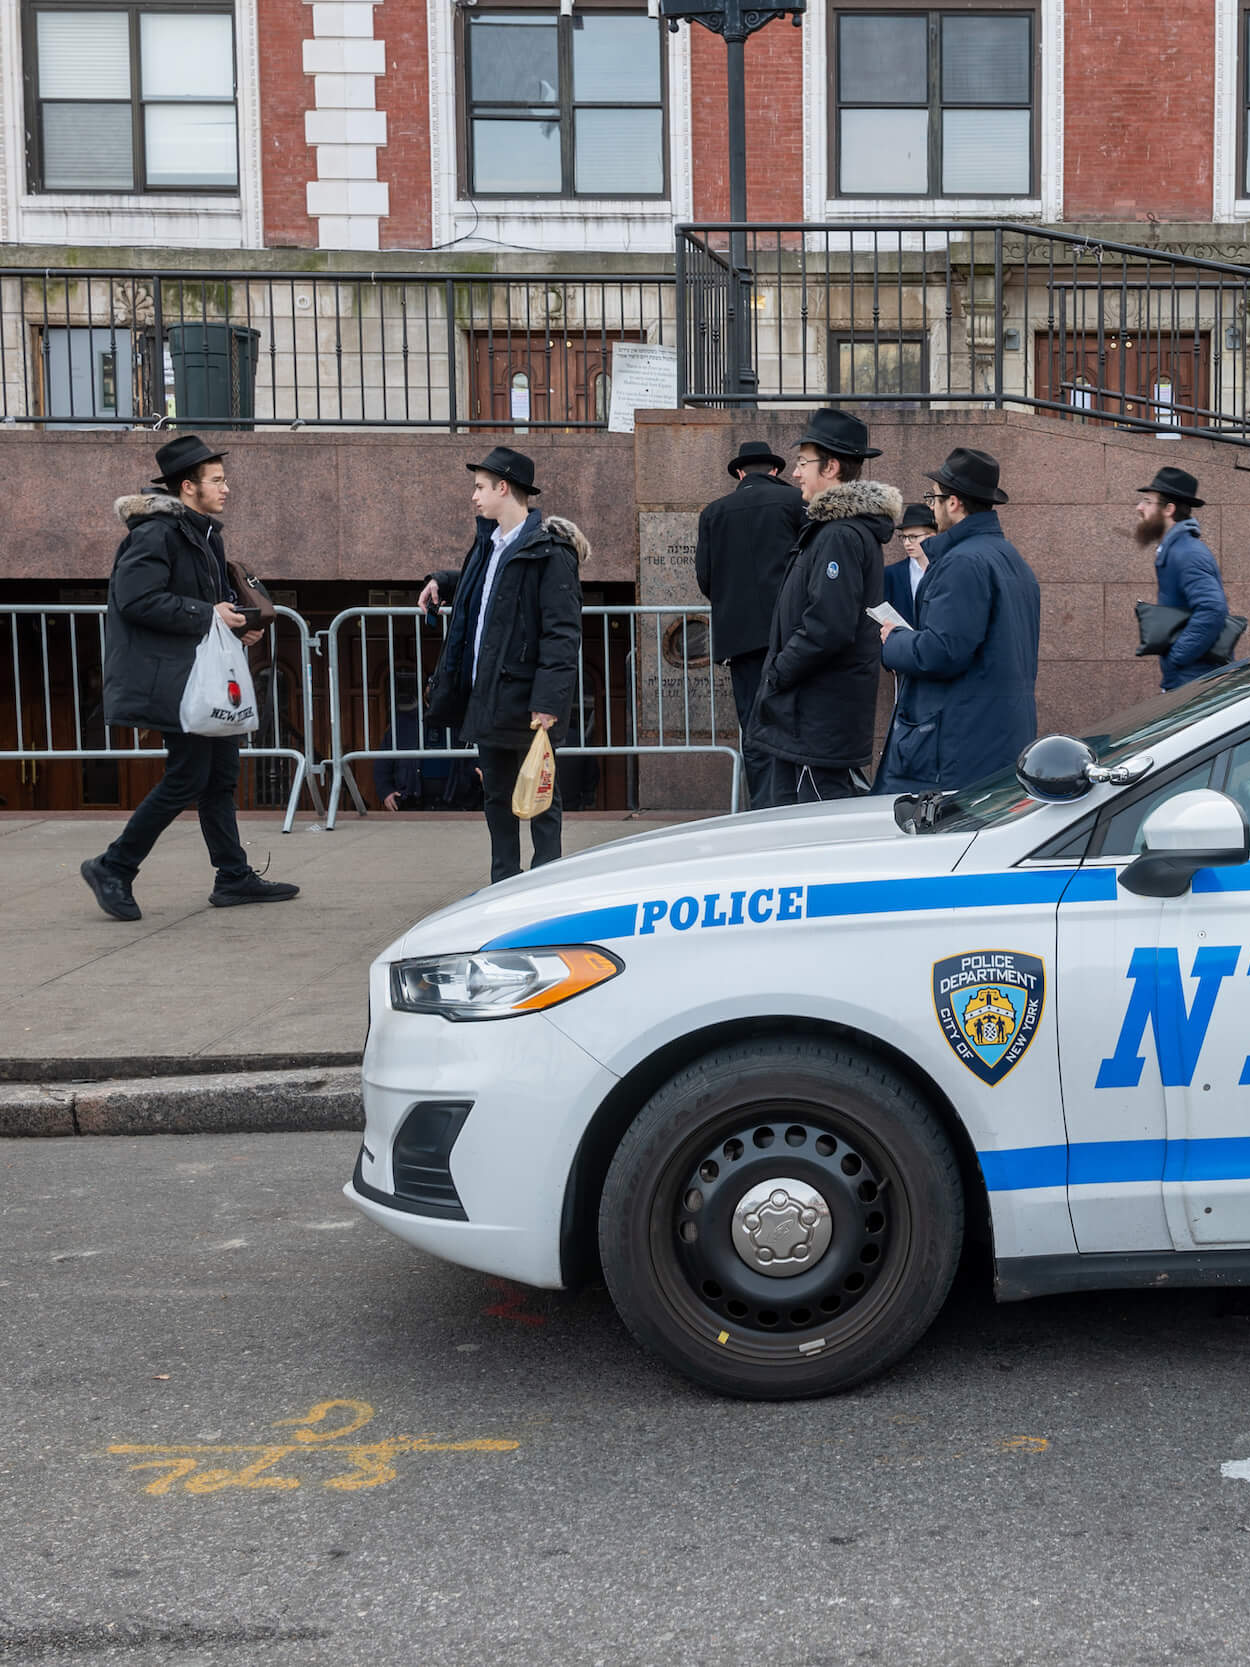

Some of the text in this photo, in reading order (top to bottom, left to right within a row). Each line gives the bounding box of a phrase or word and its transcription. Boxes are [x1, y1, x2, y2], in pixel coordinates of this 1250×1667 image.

[647, 555, 666, 565] THE
[210, 708, 236, 721] NEW
[640, 886, 803, 935] POLICE
[961, 954, 1014, 971] POLICE
[940, 968, 1037, 994] DEPARTMENT
[940, 999, 1039, 1062] CITY OF NEW YORK
